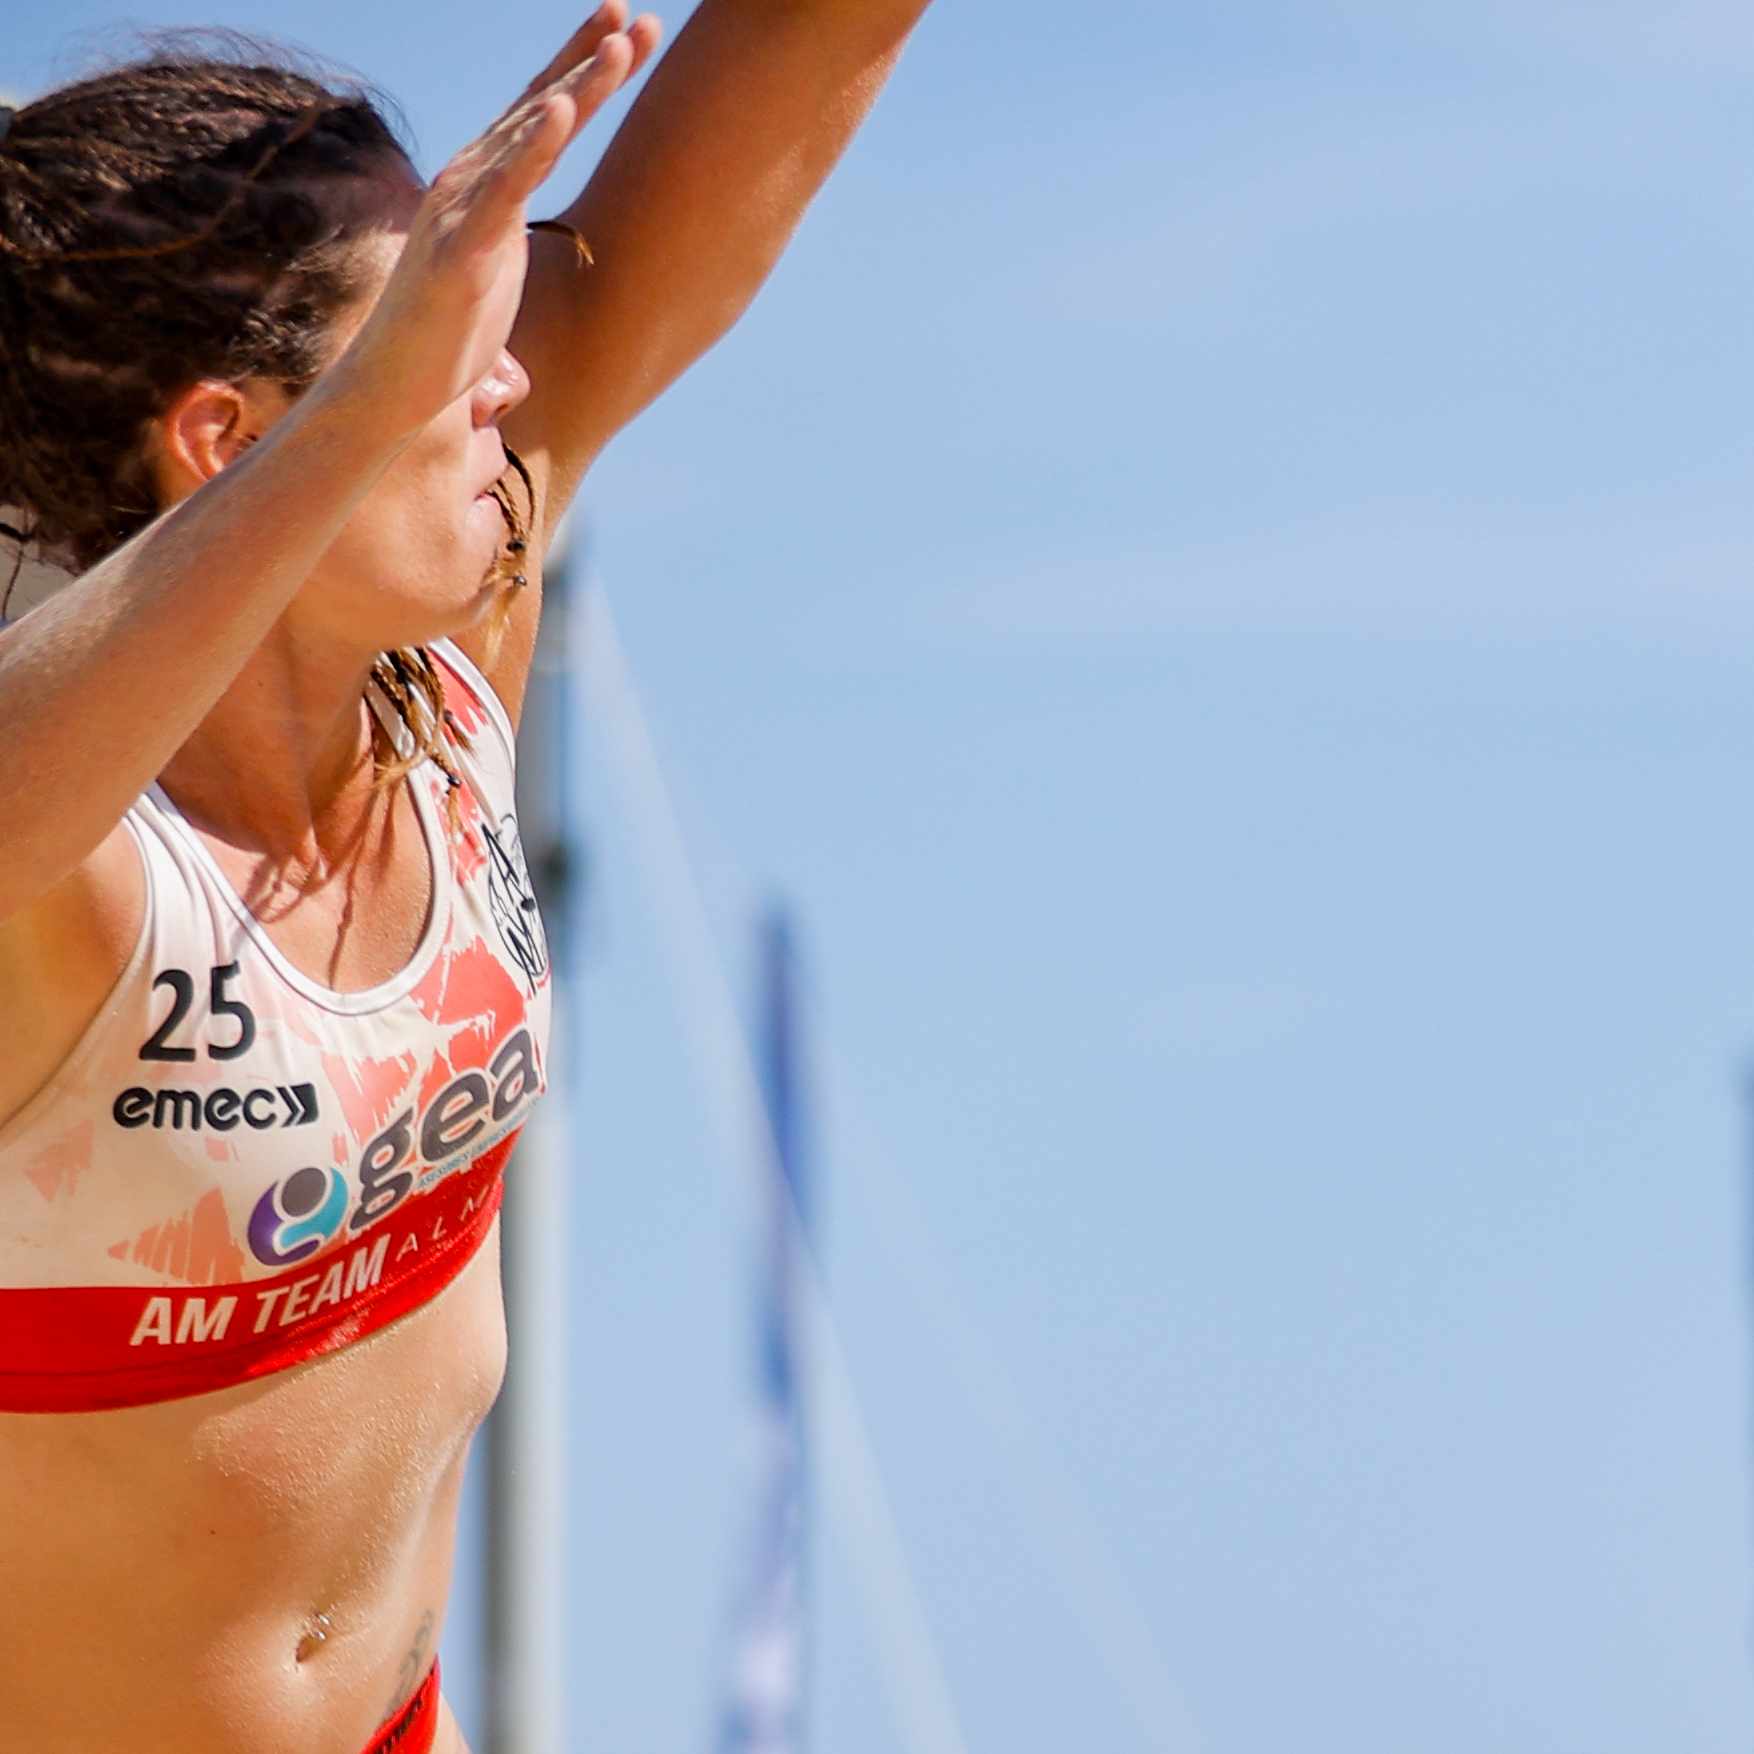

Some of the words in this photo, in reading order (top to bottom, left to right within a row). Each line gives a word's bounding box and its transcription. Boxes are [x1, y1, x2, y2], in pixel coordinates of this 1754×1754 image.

[138, 959, 256, 1062] 25
[112, 1086, 278, 1131] emec
[349, 1028, 540, 1230] gea
[129, 1296, 239, 1347] AM
[252, 1233, 391, 1334] TEAM
